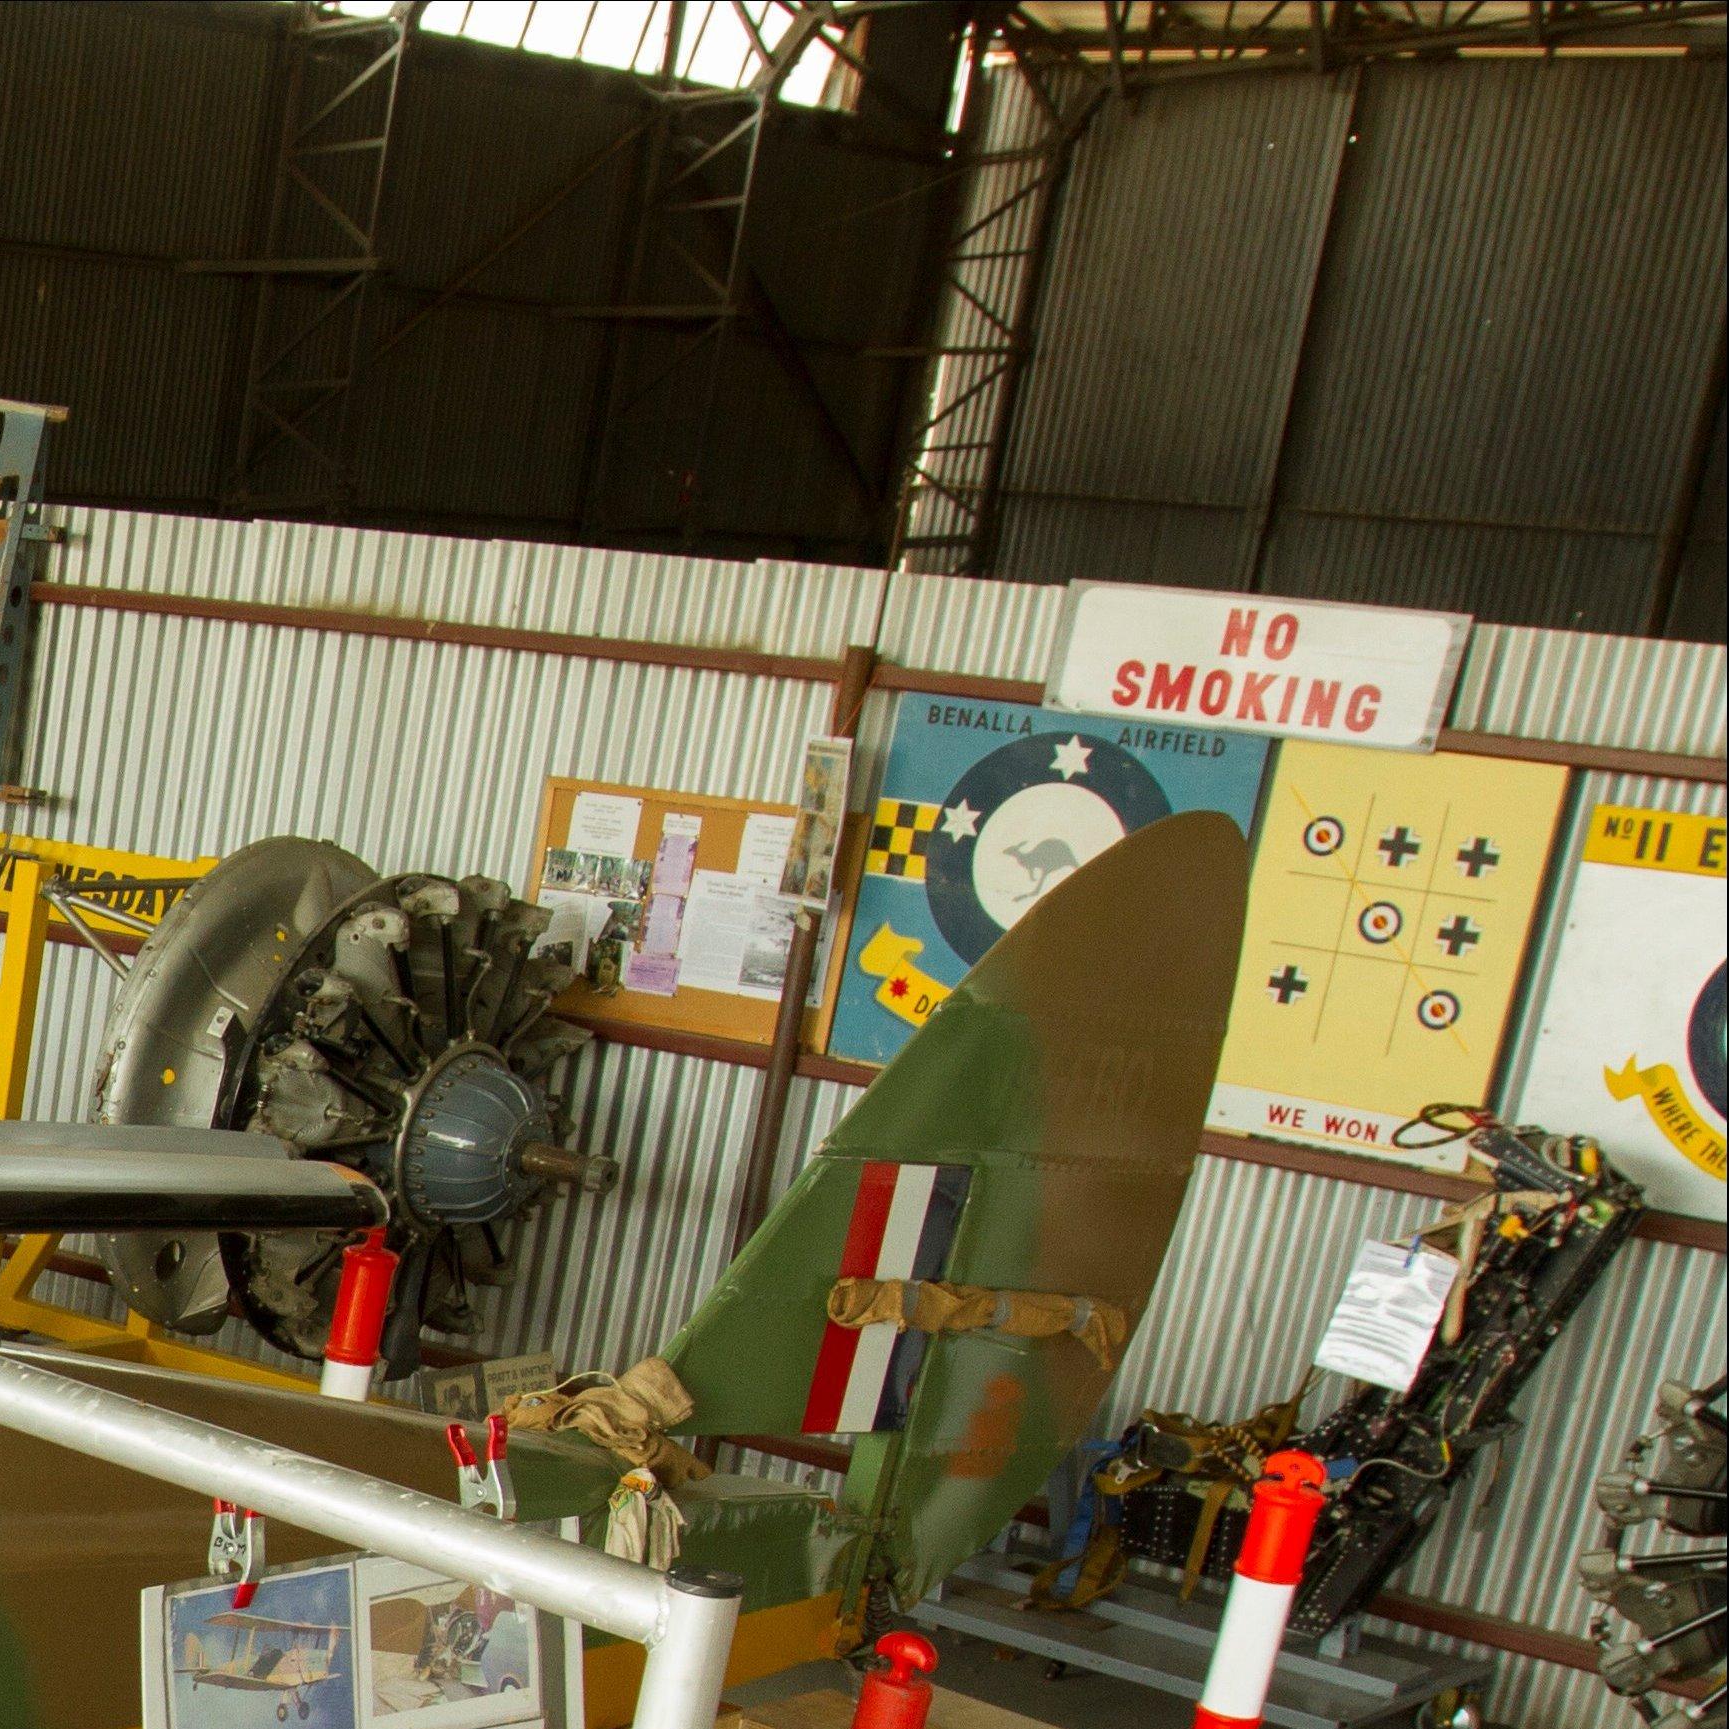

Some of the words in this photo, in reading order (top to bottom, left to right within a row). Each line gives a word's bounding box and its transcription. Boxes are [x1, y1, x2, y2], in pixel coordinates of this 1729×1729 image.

[1220, 608, 1298, 661] NO
[1112, 659, 1382, 733] SMOKING
[928, 704, 1033, 736] BENALLA
[1118, 727, 1227, 759] AIRFIELD
[1269, 1104, 1306, 1129] WE
[1324, 1114, 1379, 1143] WON
